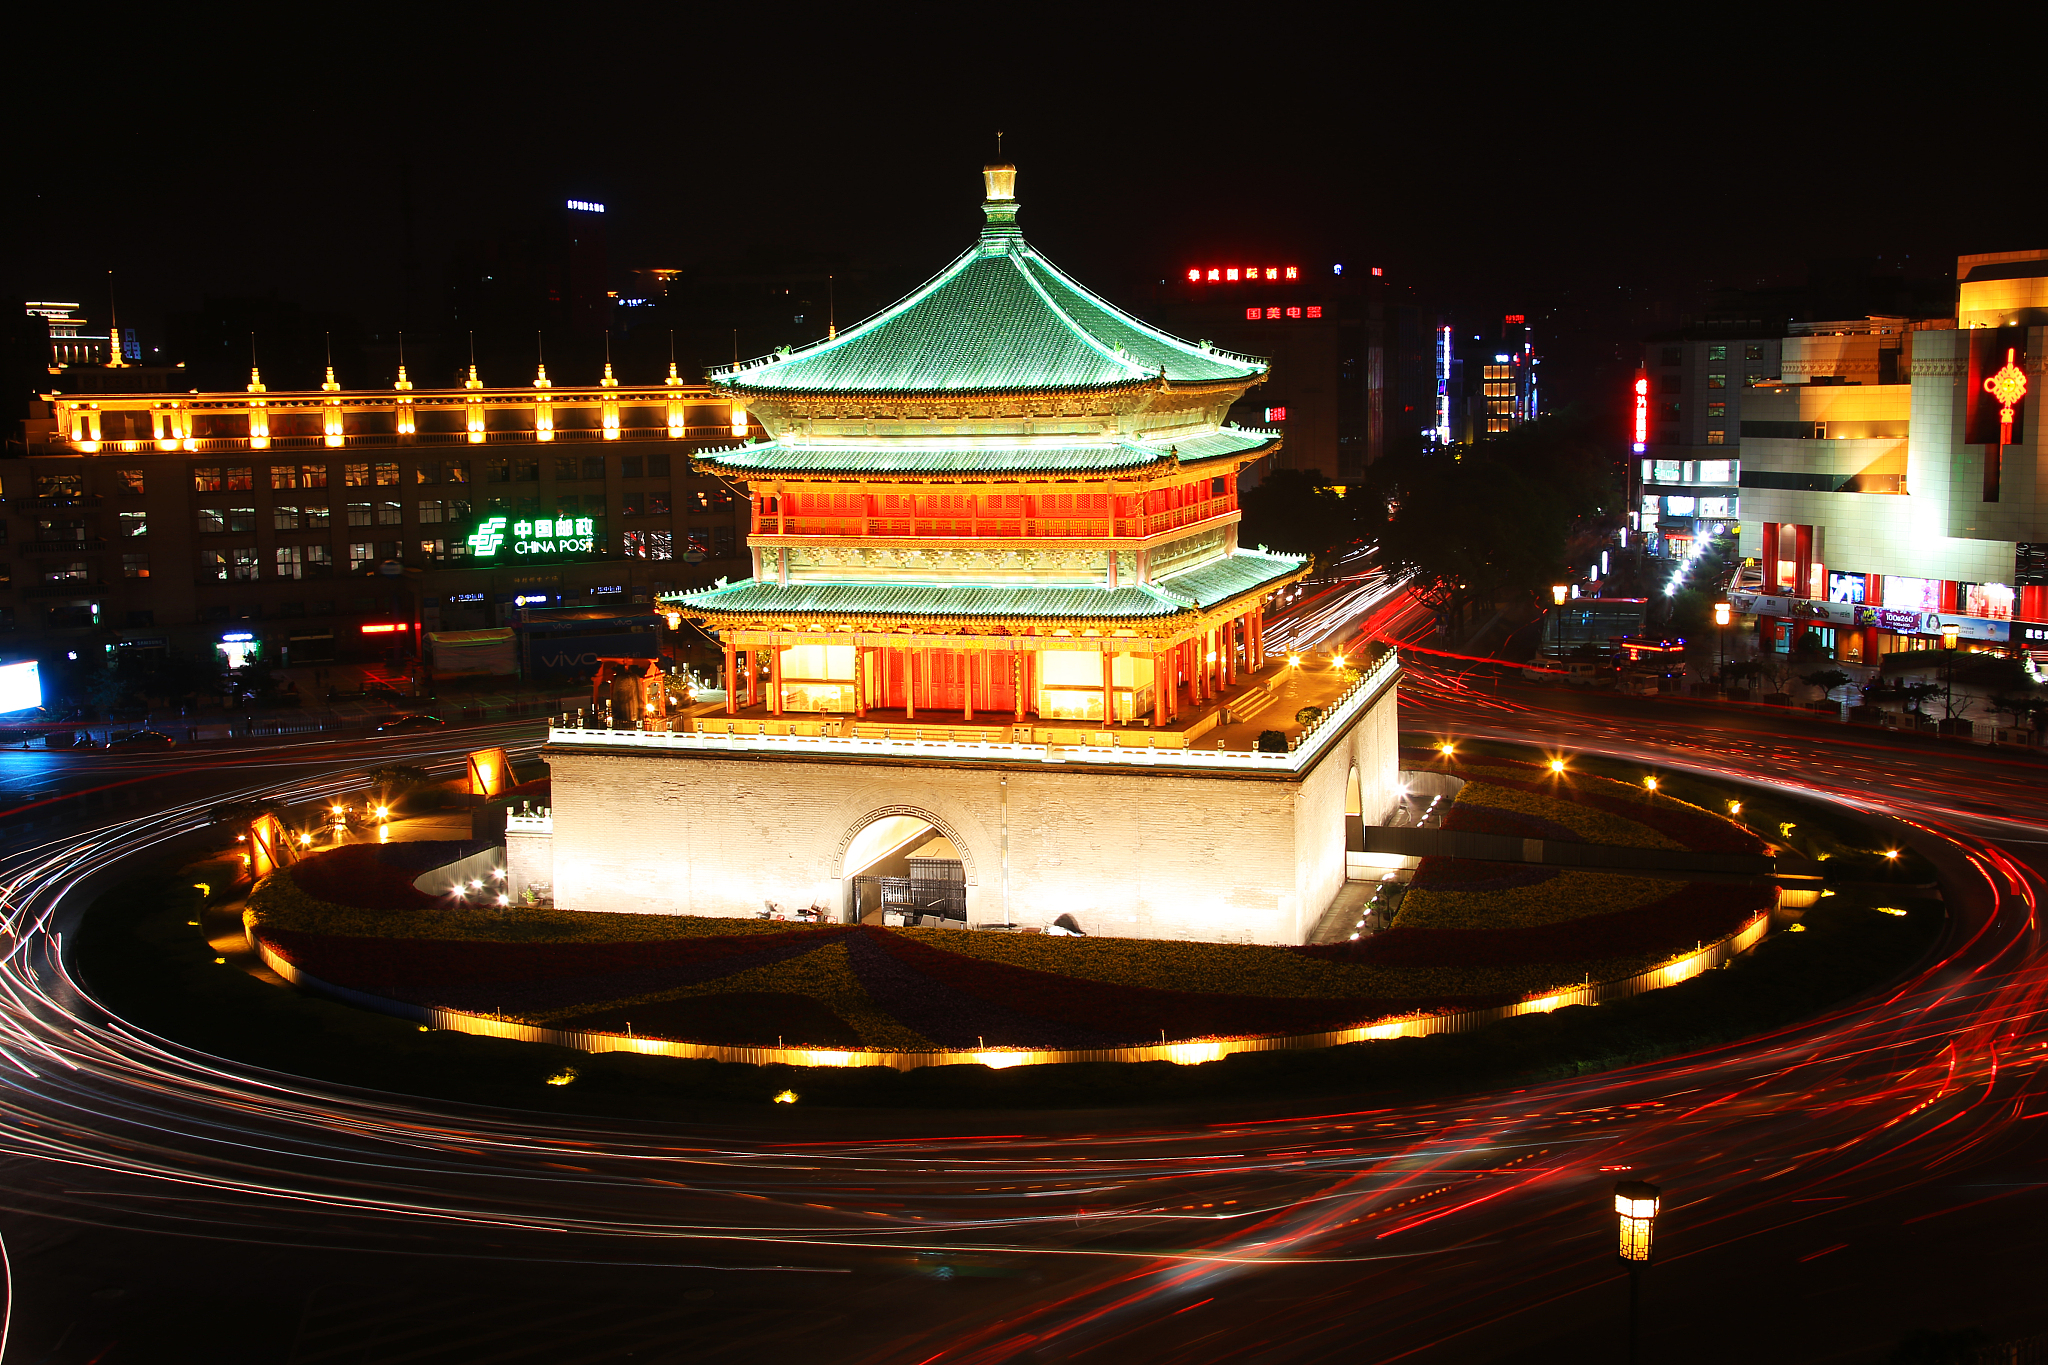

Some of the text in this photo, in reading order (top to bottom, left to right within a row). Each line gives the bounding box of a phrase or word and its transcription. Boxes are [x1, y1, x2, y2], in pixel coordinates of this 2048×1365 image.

[1246, 305, 1322, 320] 国美电器
[513, 517, 594, 539] 中国邮政
[514, 538, 594, 555] CHINA POST
[541, 650, 599, 668] vivo
